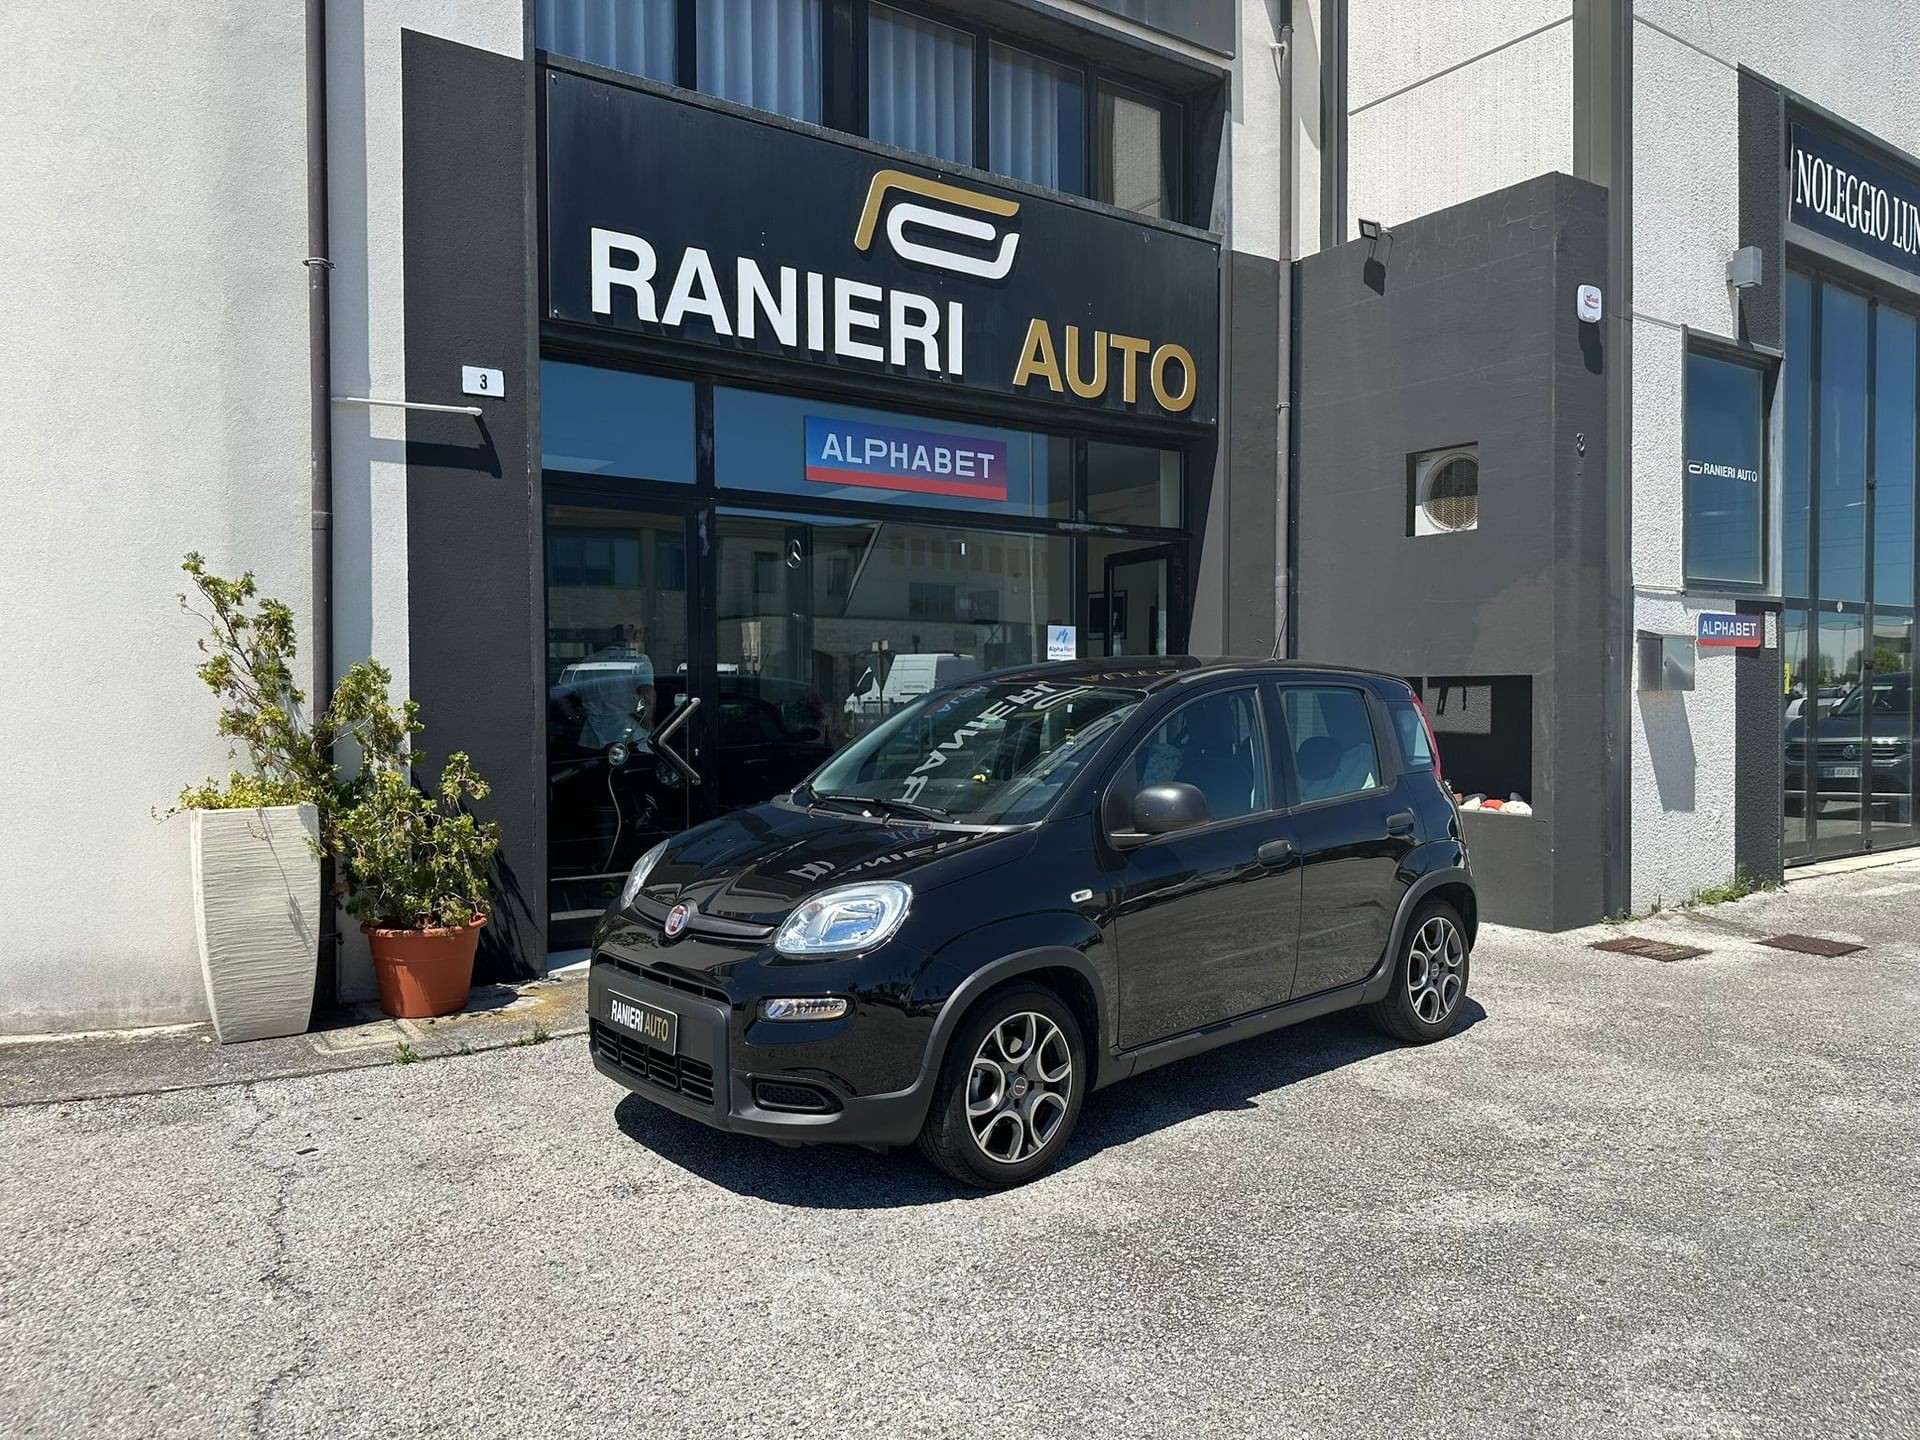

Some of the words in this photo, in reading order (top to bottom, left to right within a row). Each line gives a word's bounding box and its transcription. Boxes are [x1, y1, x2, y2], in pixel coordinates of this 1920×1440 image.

[1796, 149, 1889, 241] NOLEGGIO
[590, 227, 963, 376] RANIERI
[1013, 318, 1197, 412] AUTO
[480, 374, 488, 390] 3
[821, 433, 995, 479] ALPHABET
[1703, 463, 1736, 479] RANIERI
[1737, 469, 1758, 483] AUTO
[1701, 620, 1757, 637] ALPHABET
[611, 1000, 644, 1032] RANIERI
[644, 1013, 669, 1042] AUTO
